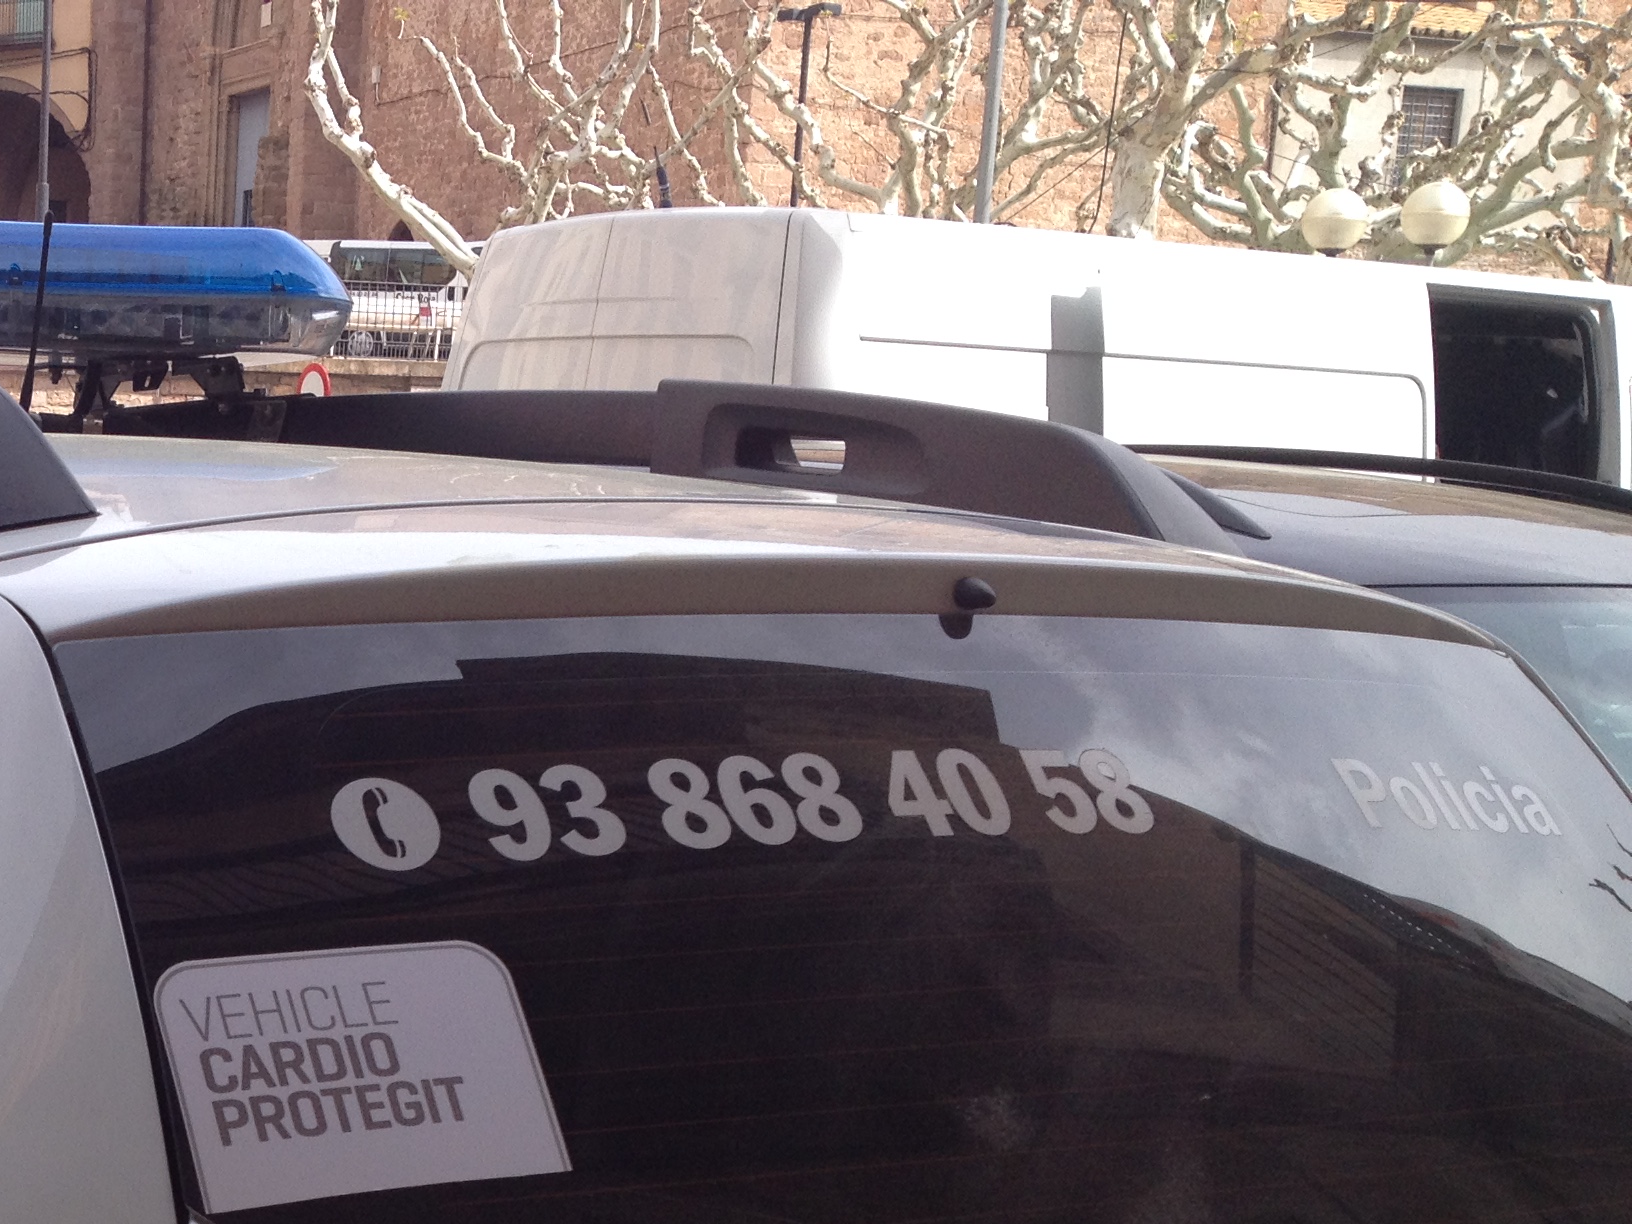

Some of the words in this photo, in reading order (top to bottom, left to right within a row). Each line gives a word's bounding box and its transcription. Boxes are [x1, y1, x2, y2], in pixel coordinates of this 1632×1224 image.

[467, 764, 627, 862] 93
[647, 752, 863, 850] 868
[886, 747, 1011, 838] 40
[1018, 748, 1155, 835] 58
[1330, 758, 1563, 836] Policia
[179, 981, 399, 1043] VEHICLE
[199, 1032, 402, 1094] CARDIO
[212, 1076, 465, 1148] PROTEGIT
